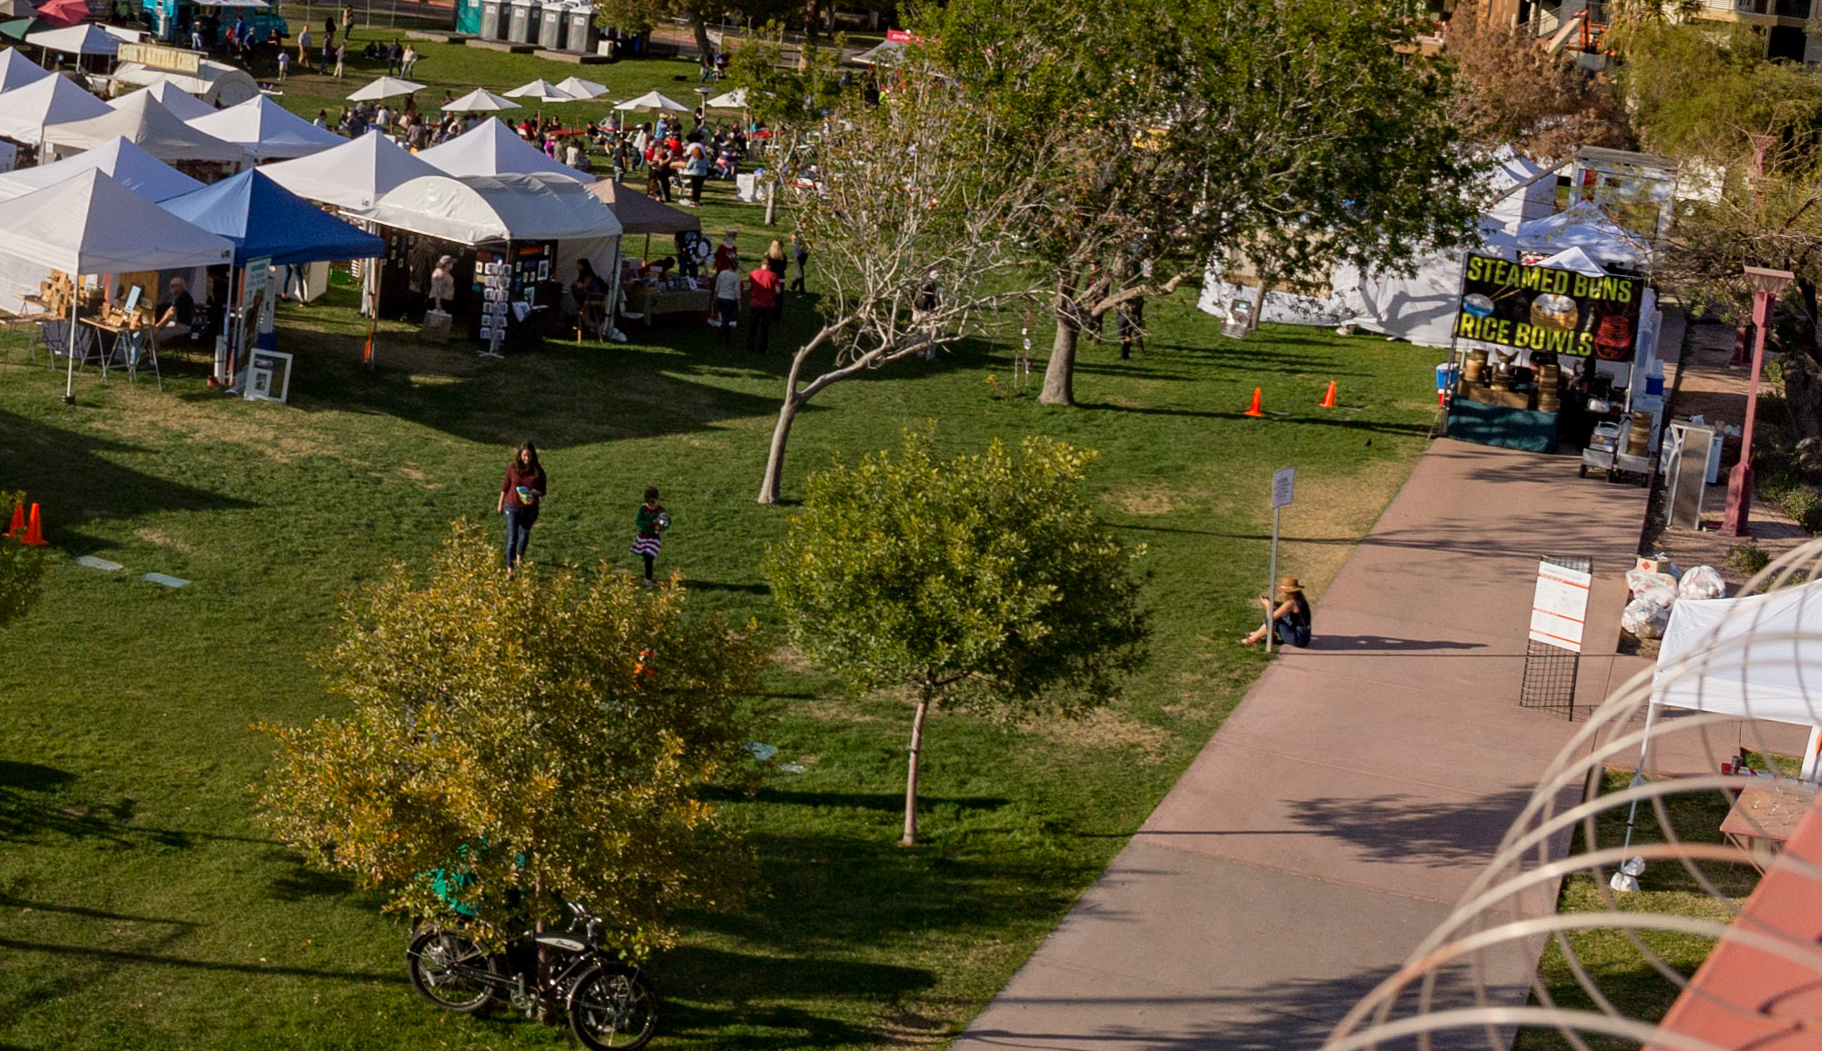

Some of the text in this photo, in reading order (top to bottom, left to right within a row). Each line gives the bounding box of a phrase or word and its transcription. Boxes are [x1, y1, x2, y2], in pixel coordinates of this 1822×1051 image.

[146, 46, 176, 68] KETTLE
[1467, 256, 1633, 303] STEAMED BUNS
[1459, 313, 1594, 356] RICE BOWLS
